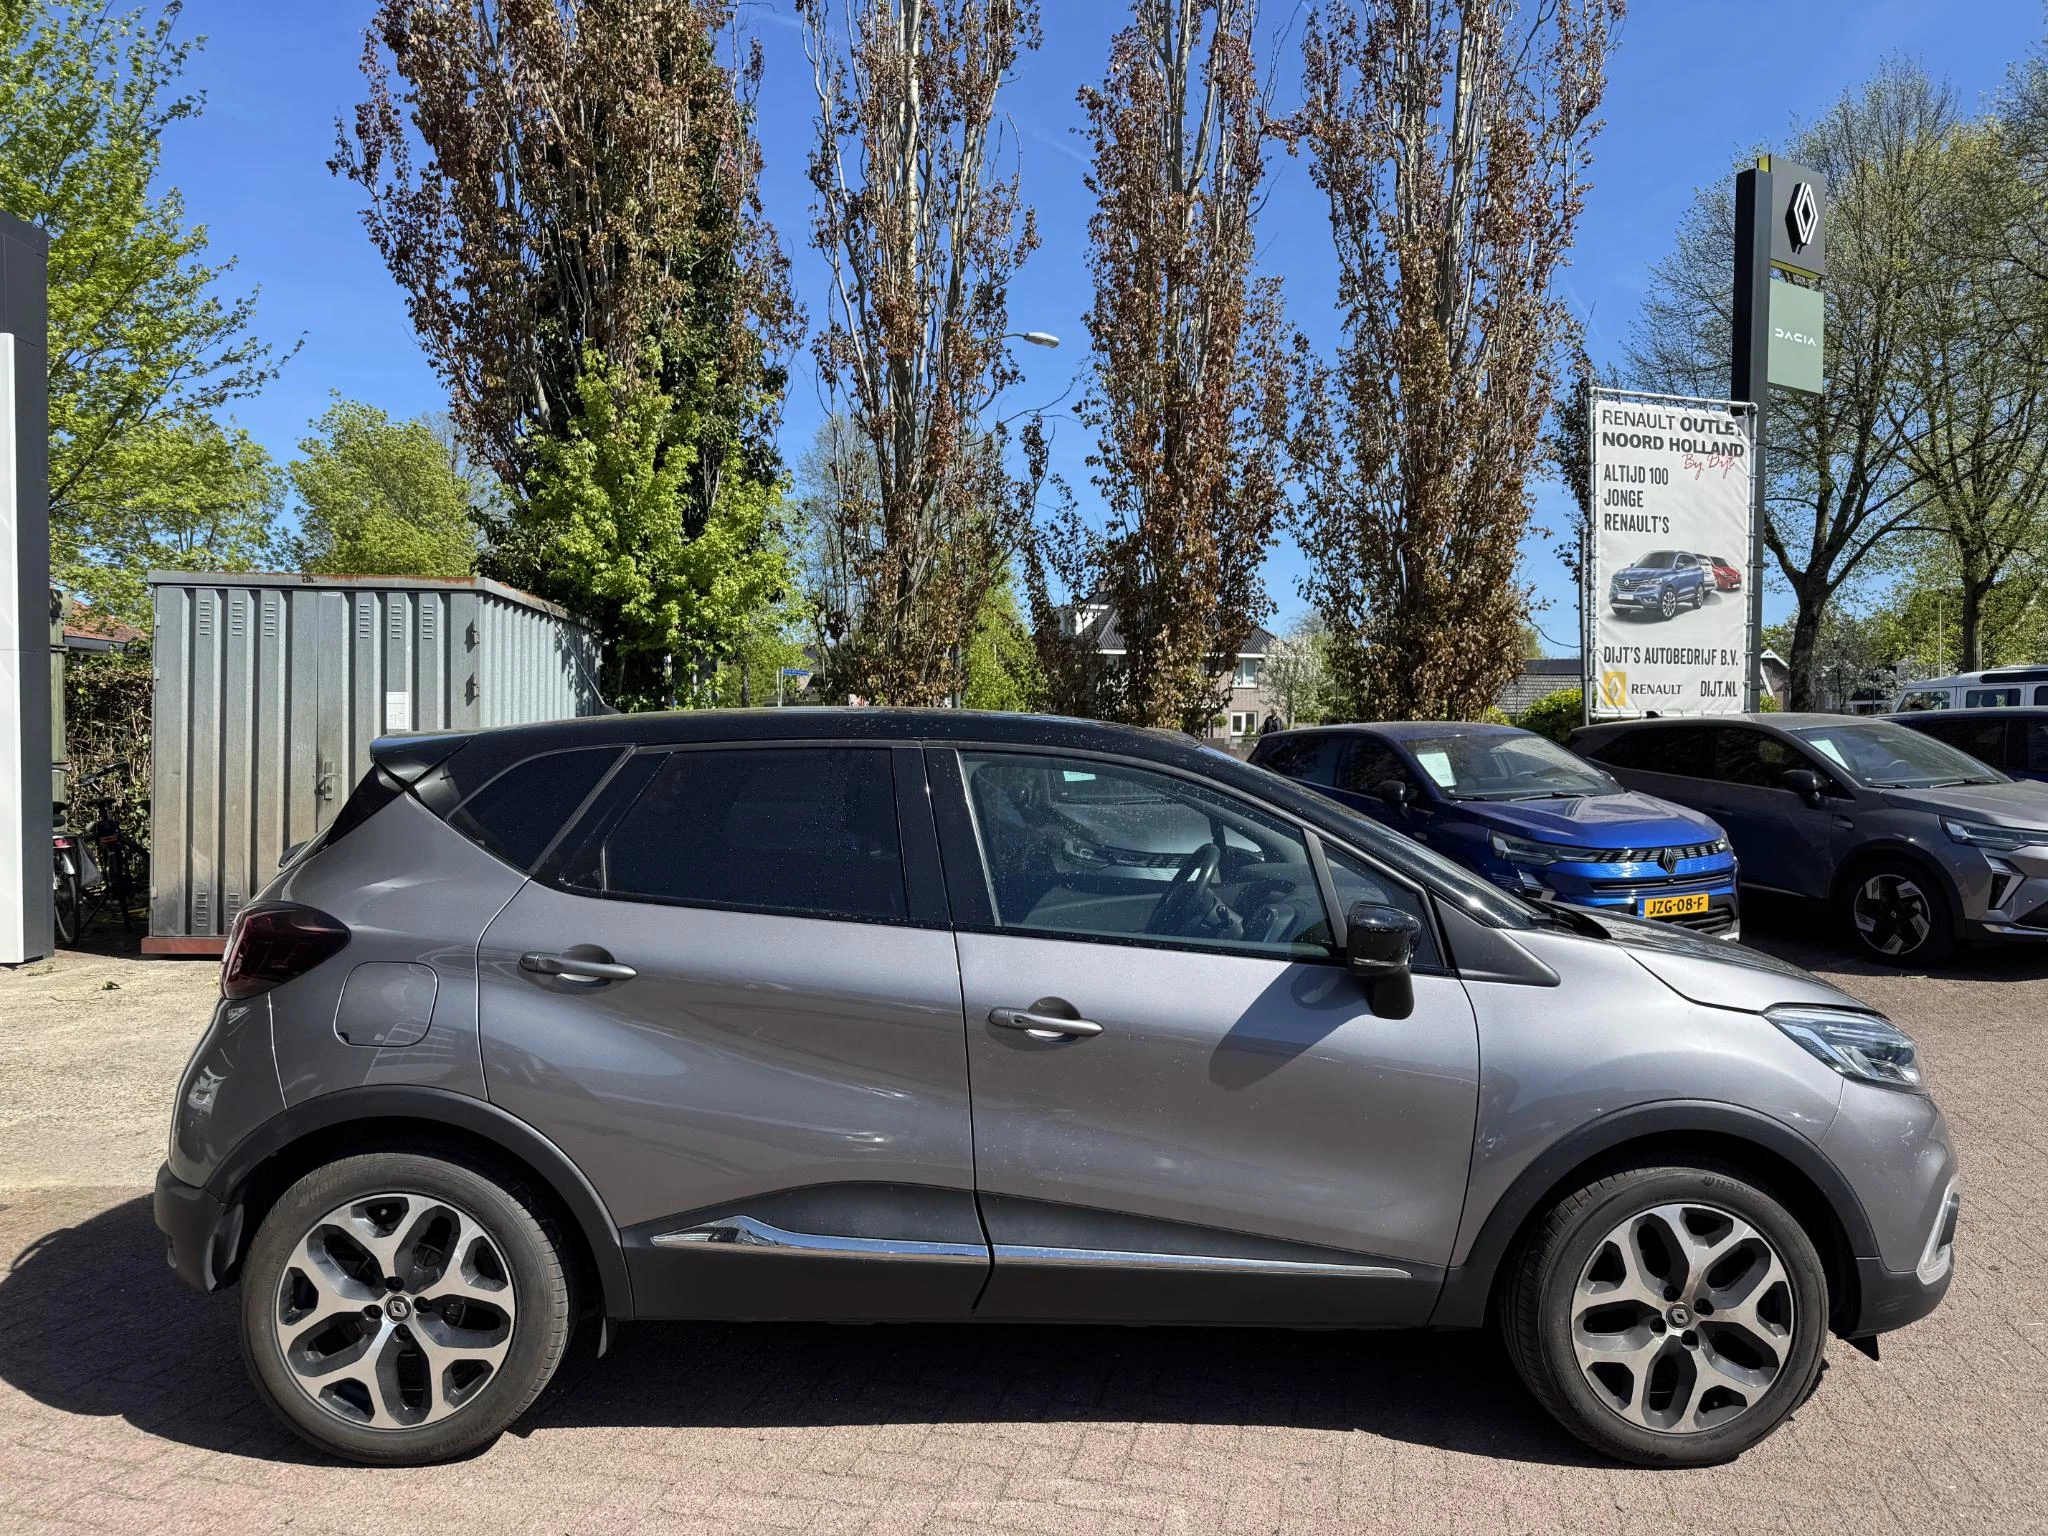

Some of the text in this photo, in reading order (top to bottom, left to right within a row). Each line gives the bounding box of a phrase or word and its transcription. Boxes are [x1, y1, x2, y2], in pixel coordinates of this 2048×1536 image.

[1775, 328, 1816, 347] DACIA
[1602, 409, 1675, 430] RENAULT
[1602, 431, 1745, 458] NOORD HOLLAND
[1603, 463, 1669, 485] ALTIJD 100
[1681, 453, 1704, 481] By
[1603, 488, 1644, 508] JONGE
[1604, 513, 1670, 534] RENAULT'S
[1603, 646, 1739, 667] DIJT'S AUTOBEDRIJF B.V.
[1631, 680, 1738, 697] RENAULT DIJT.NL
[1649, 896, 1705, 915] JZG-08-F
